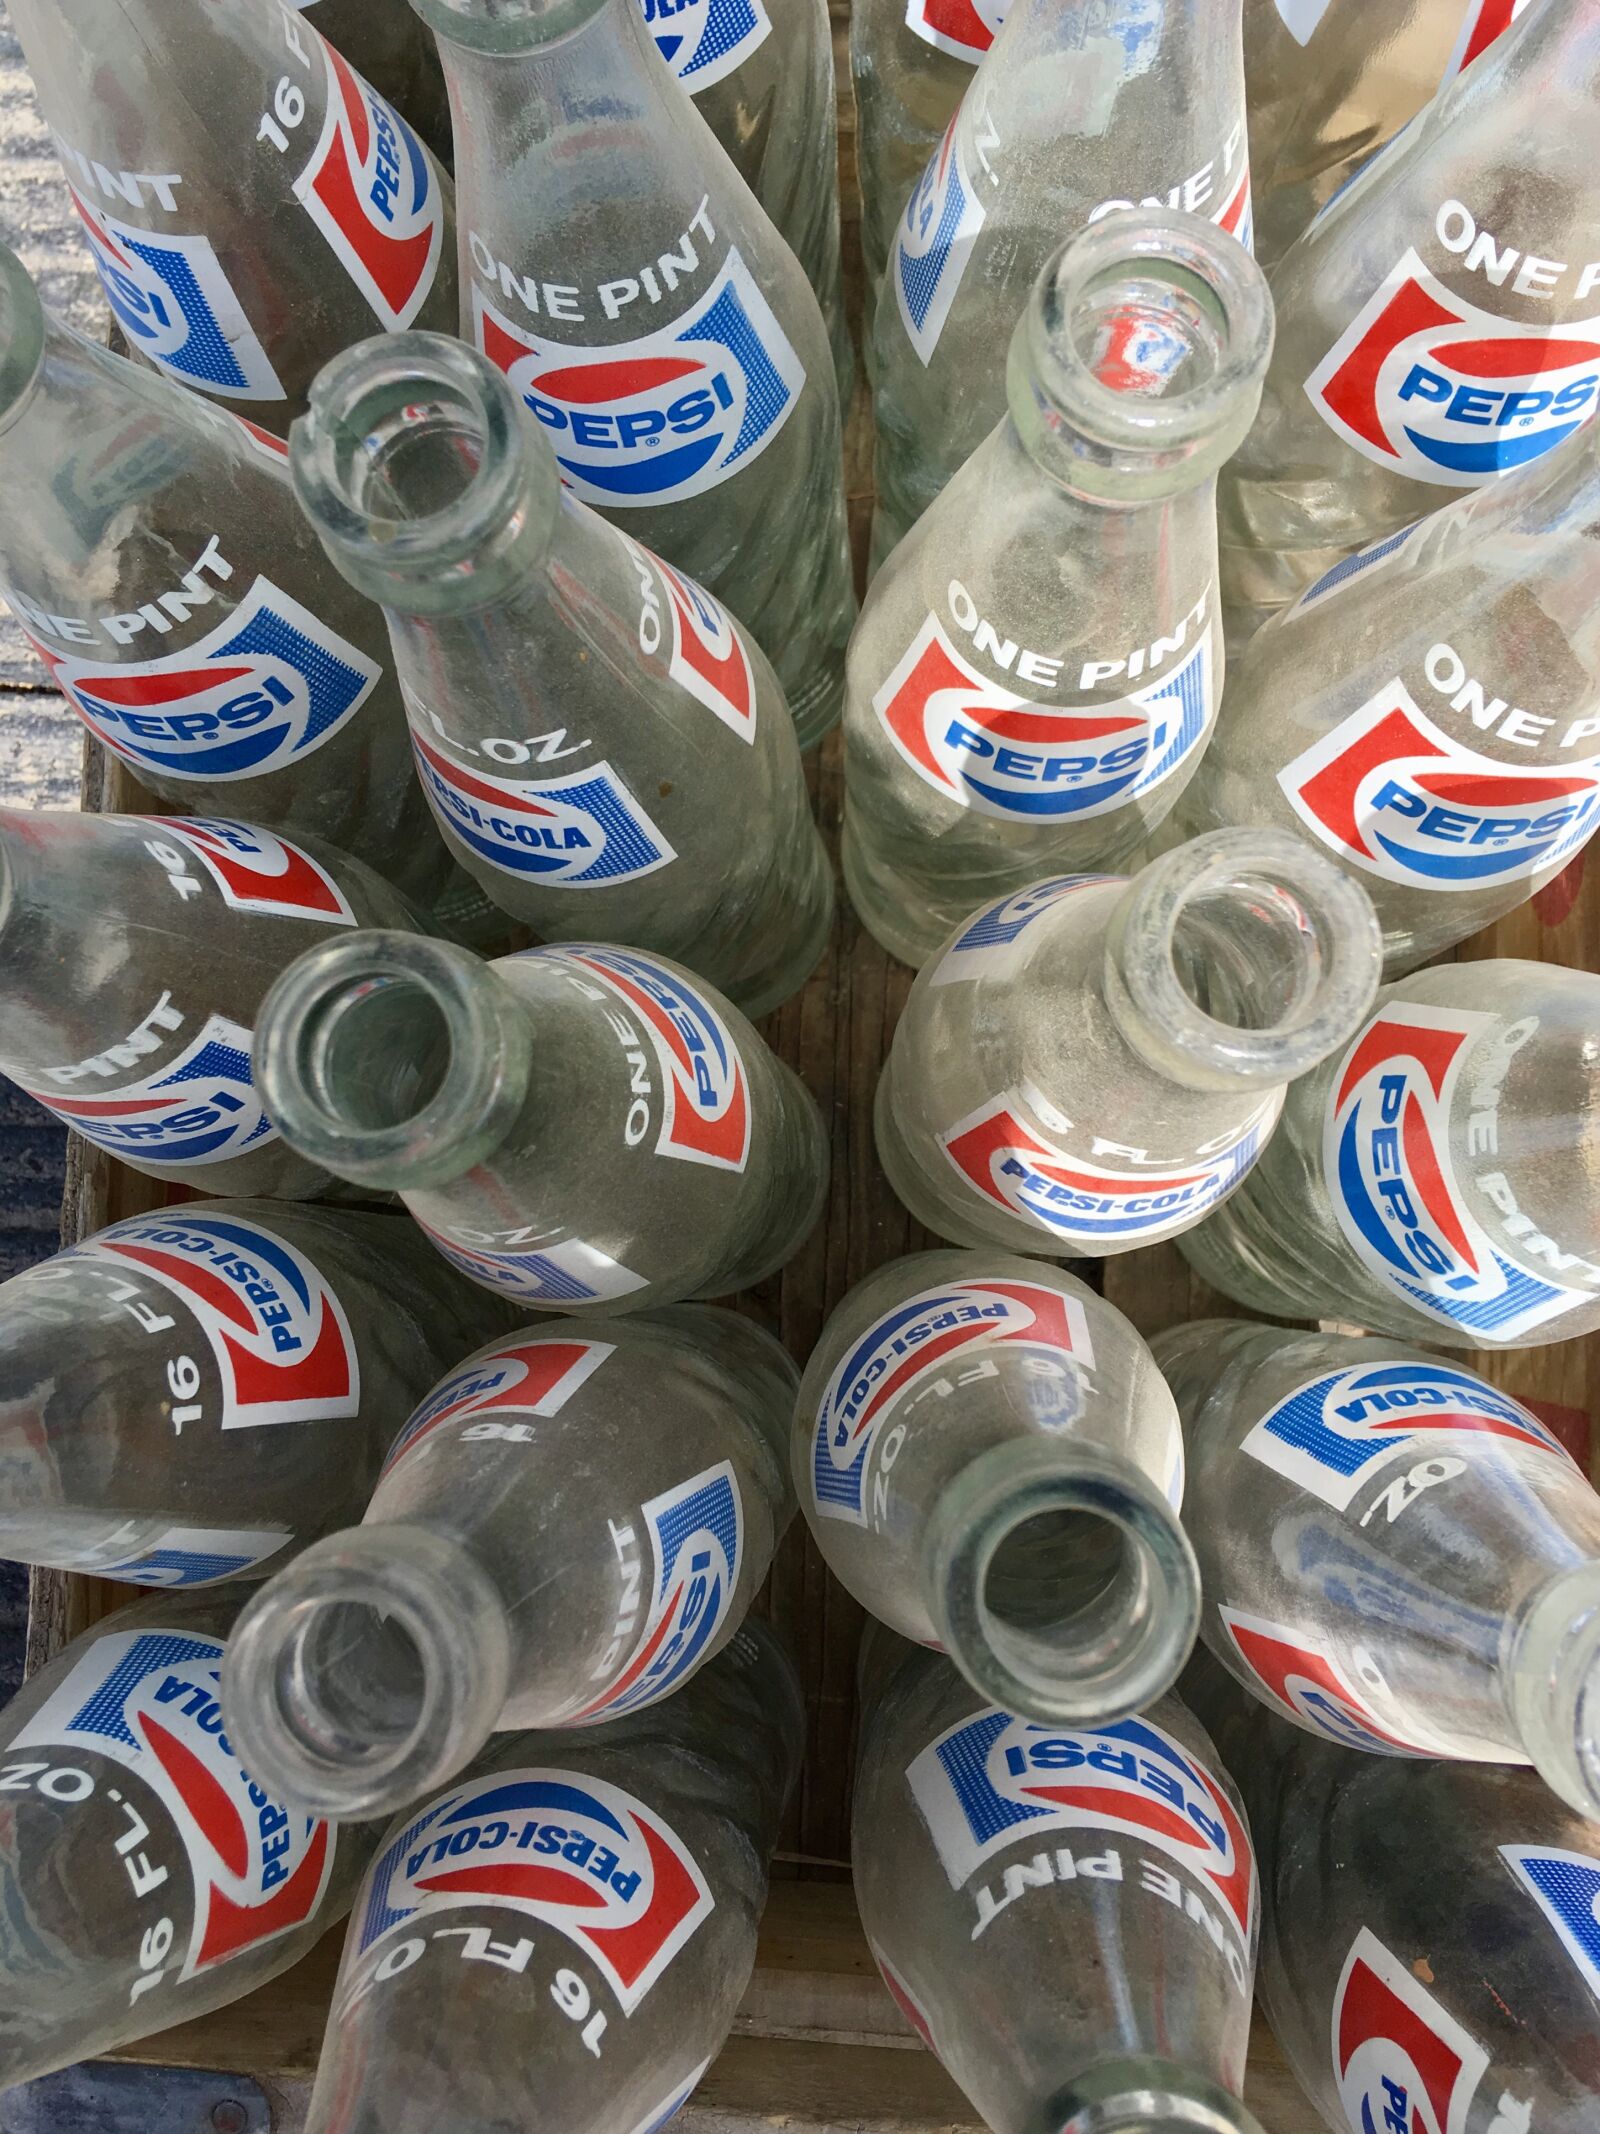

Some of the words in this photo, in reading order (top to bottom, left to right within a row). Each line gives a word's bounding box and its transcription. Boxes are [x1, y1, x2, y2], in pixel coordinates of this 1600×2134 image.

[255, 75, 305, 154] 16
[468, 229, 586, 323] ONE
[596, 192, 717, 320] PINT
[1435, 199, 1569, 300] ONE
[1398, 362, 1600, 428] PEPS
[98, 534, 235, 645] PINT
[946, 579, 1066, 688] ONE
[1079, 578, 1213, 690] PINT
[70, 675, 296, 742] PEPSI
[1424, 642, 1557, 748] ONE
[943, 719, 1168, 783] PEPSI
[1370, 779, 1597, 846] PEPSI
[143, 839, 203, 902] 16
[40, 989, 186, 1086] PINT
[600, 1007, 652, 1147] ONE
[1000, 1157, 1221, 1214] PEPSI-COLA
[1371, 1074, 1480, 1291] PEPSI
[104, 1226, 303, 1353] PEPSI-COLA
[167, 1355, 203, 1436] 16
[833, 1302, 1010, 1448] PEPSI-COLA
[588, 1518, 642, 1682] PINT
[1004, 1739, 1227, 1857] PEPSI
[405, 1821, 643, 1904] PEPSI-COLA
[970, 1848, 1124, 1942] PINT
[129, 1916, 174, 2007] 16
[1138, 1857, 1247, 1999] ONE
[549, 1968, 608, 2059] 16
